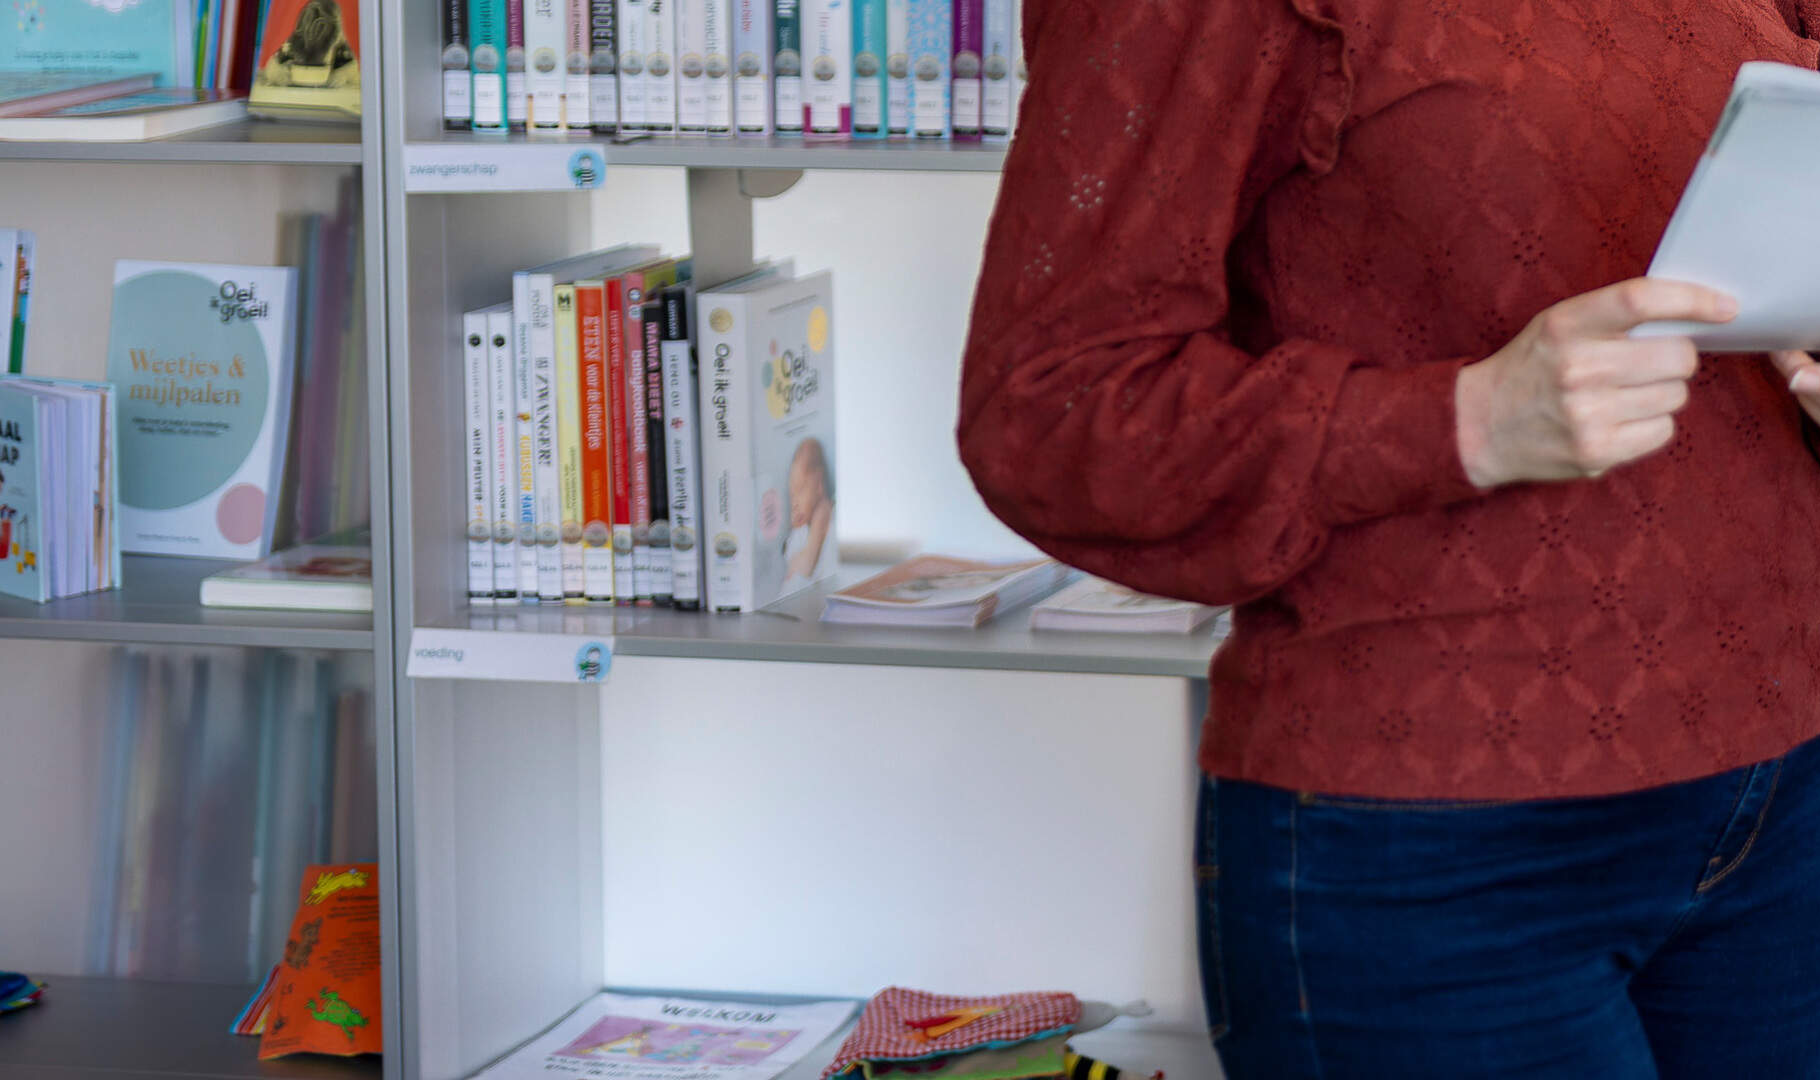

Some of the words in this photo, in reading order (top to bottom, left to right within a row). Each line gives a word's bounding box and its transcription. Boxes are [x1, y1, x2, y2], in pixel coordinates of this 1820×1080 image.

[409, 163, 498, 177] zwangerschap
[219, 299, 268, 325] groei!
[583, 315, 602, 361] ETEN
[645, 322, 661, 368] MAMA
[128, 348, 220, 380] Weetjes
[227, 352, 246, 379] &
[586, 363, 600, 386] voor
[128, 378, 241, 407] mijlpalen
[586, 388, 601, 402] de
[647, 373, 663, 419] DIEET
[714, 380, 731, 392] ik
[630, 349, 648, 454] babykookboek
[711, 395, 732, 438] groei!
[415, 648, 465, 662] voeding
[660, 1002, 777, 1024] WELKOM
